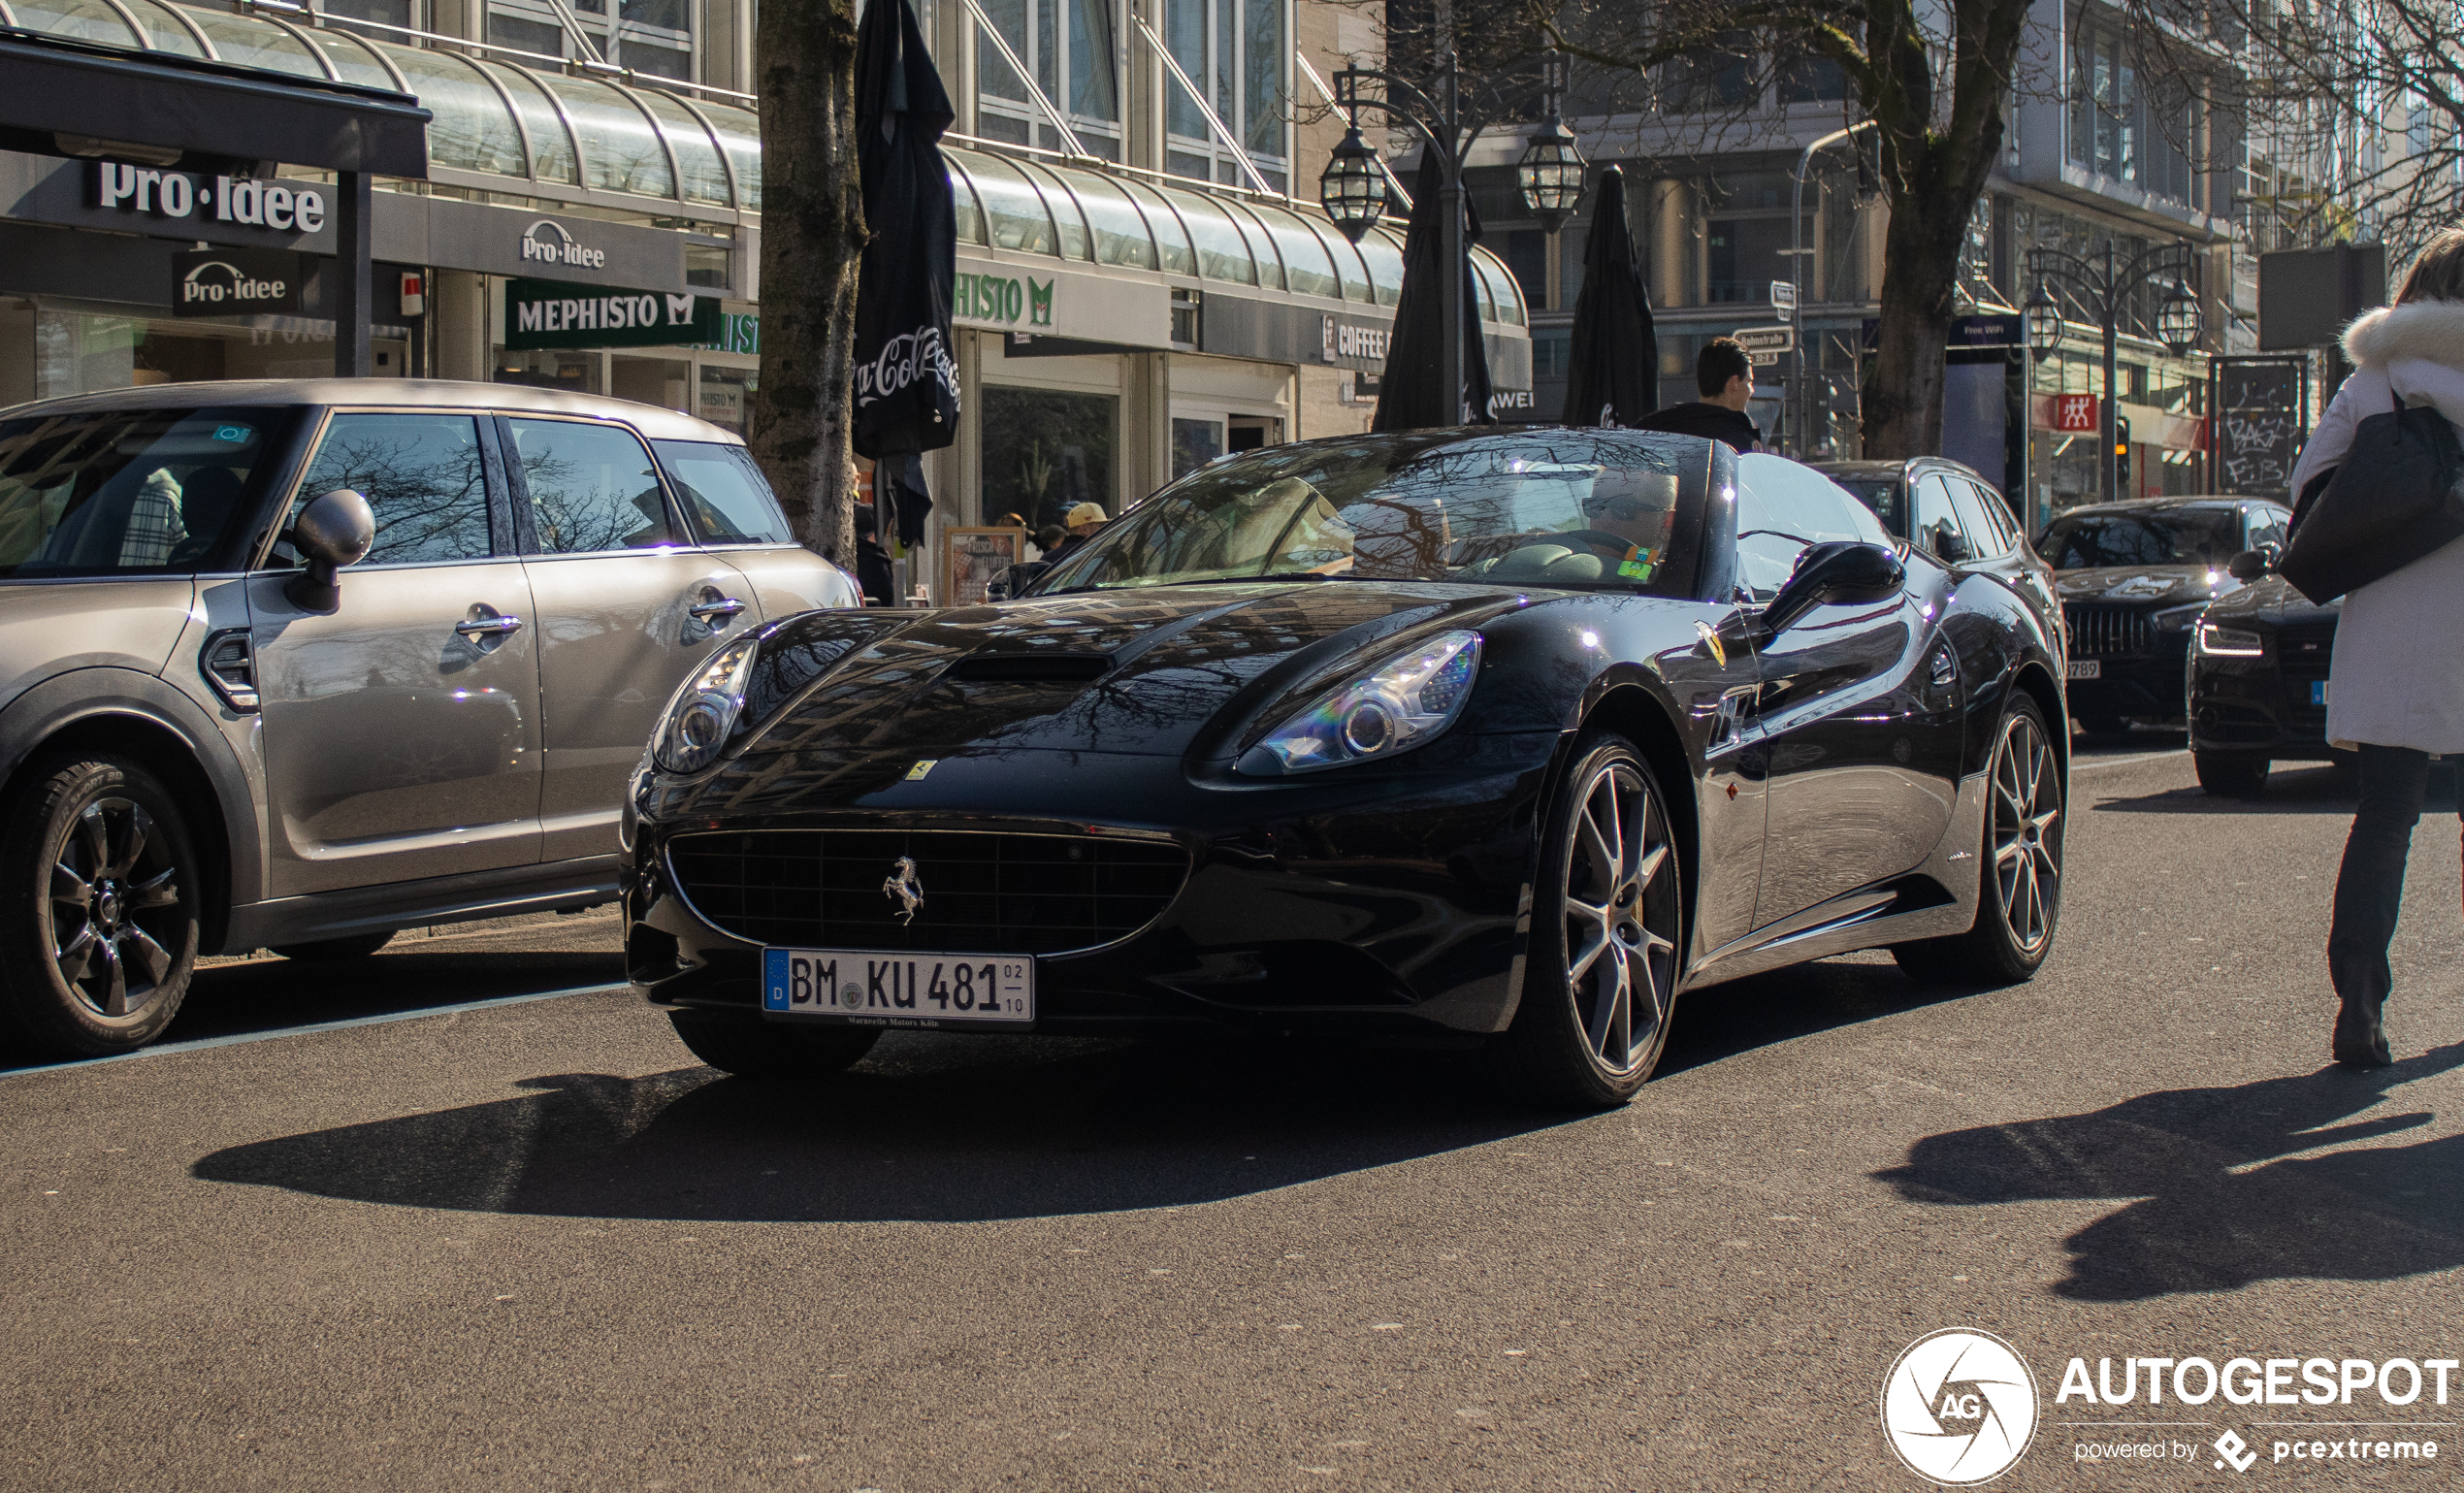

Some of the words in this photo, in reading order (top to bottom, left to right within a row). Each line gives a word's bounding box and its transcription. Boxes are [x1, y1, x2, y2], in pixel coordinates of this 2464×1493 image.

[954, 273, 1023, 322] HISTO
[518, 295, 659, 332] MEPHISTO
[1964, 325, 1983, 335] Free
[1338, 325, 1384, 359] COFFEE
[2066, 663, 2096, 676] 789
[1004, 964, 1023, 978] 02
[791, 957, 838, 1005] BM
[867, 960, 917, 1009] KU
[927, 962, 1001, 1011] 481
[773, 987, 784, 1000] D
[1006, 998, 1023, 1013] 10
[890, 1018, 918, 1026] Motors
